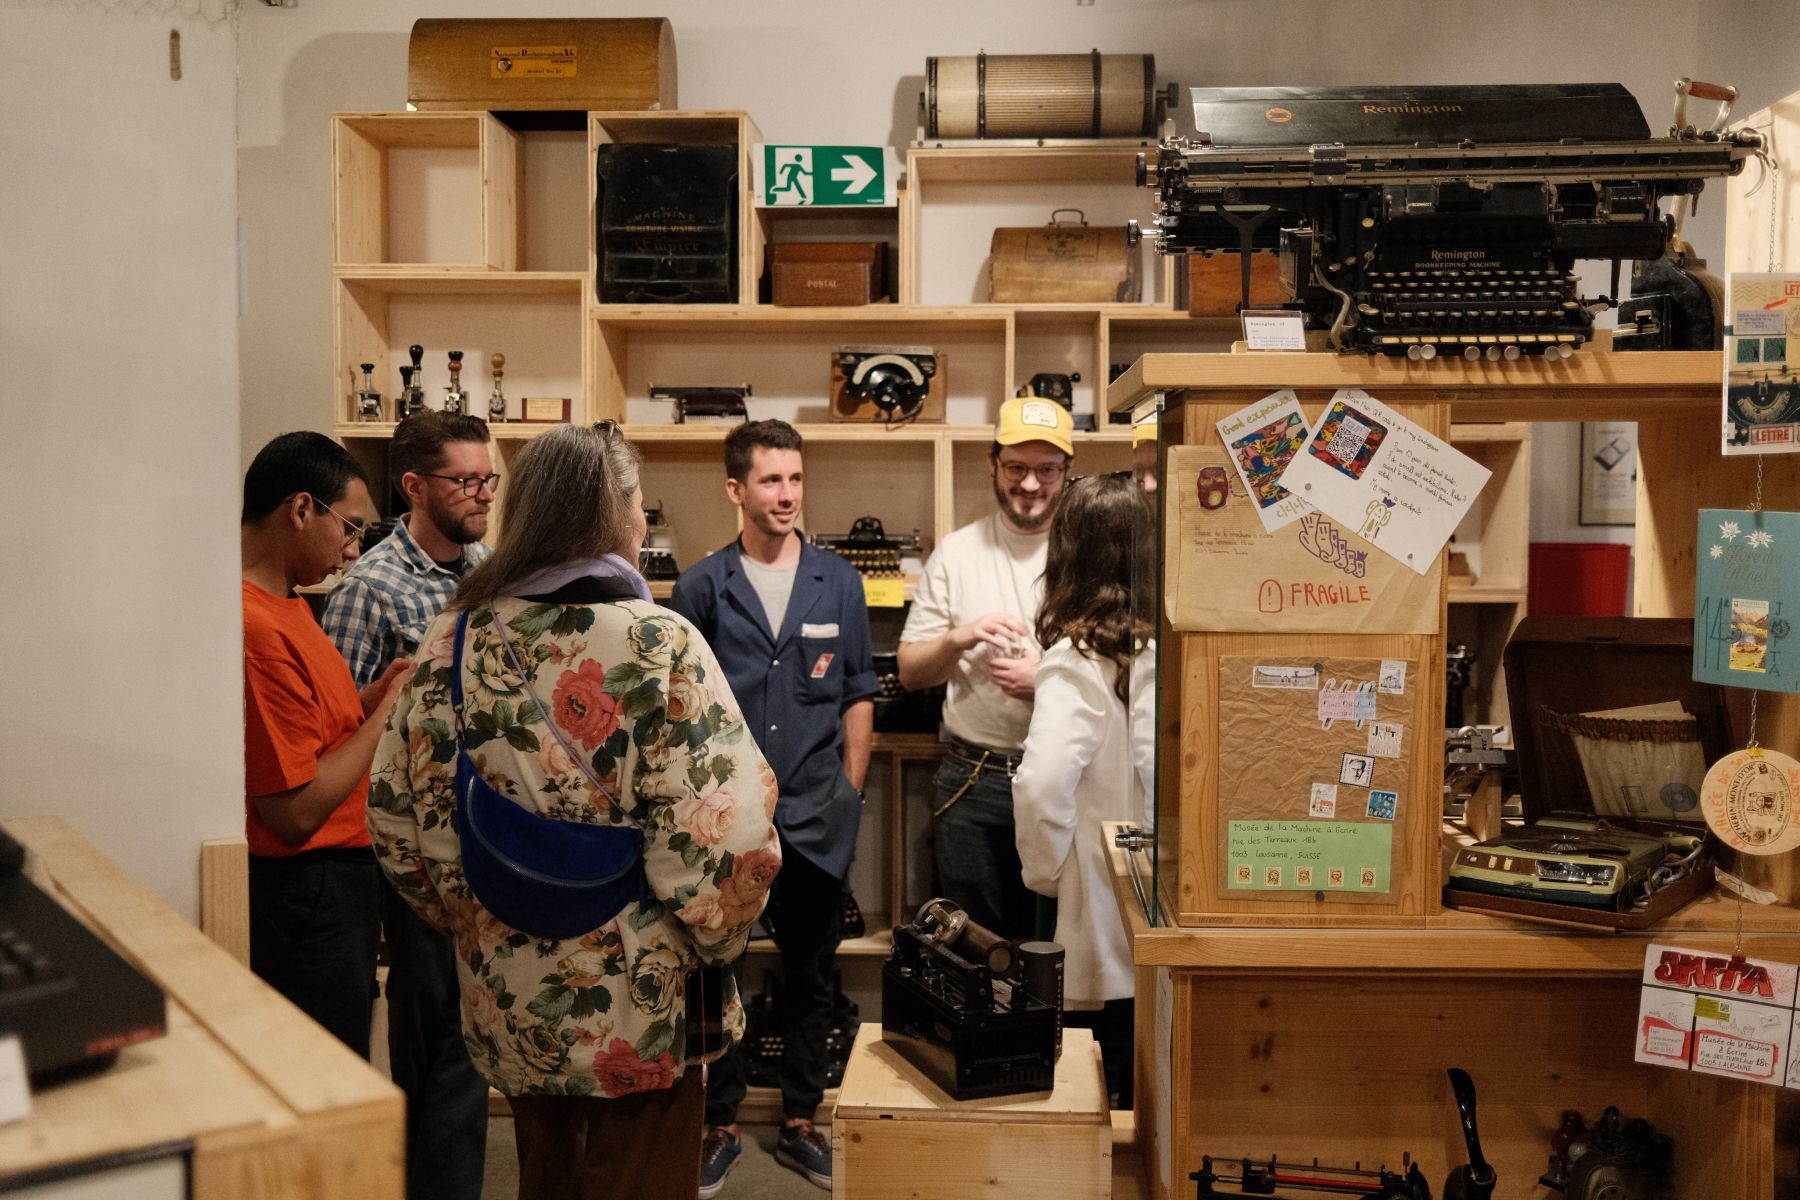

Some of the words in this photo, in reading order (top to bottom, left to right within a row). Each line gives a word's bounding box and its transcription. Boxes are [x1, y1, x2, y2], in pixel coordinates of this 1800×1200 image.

[1363, 104, 1463, 114] Remington
[1432, 250, 1485, 261] Remington
[1470, 261, 1501, 269] MACHINE
[1371, 408, 1382, 418] QR
[1220, 415, 1245, 436] Good
[1756, 428, 1790, 442] LETTRE
[1234, 823, 1259, 832] Musée
[1278, 822, 1287, 831] la
[1290, 824, 1322, 834] Machine
[1248, 836, 1261, 845] des
[1264, 836, 1297, 845] Terreaux
[1701, 1034, 1724, 1045] Musée
[1744, 1042, 1771, 1053] Machine
